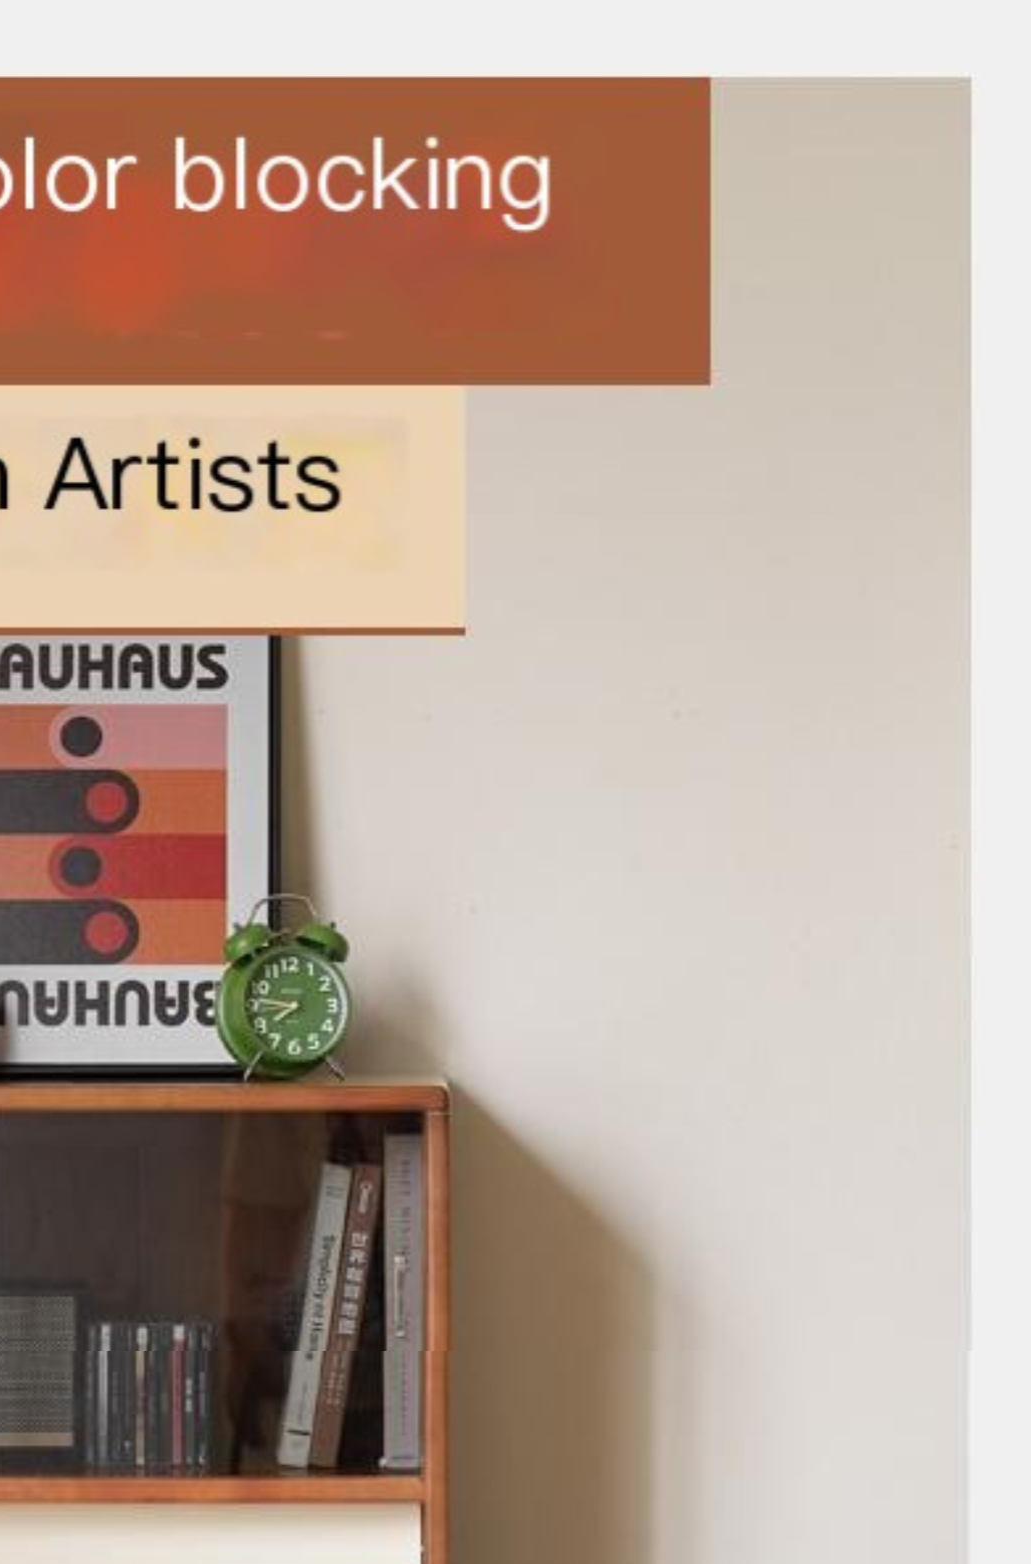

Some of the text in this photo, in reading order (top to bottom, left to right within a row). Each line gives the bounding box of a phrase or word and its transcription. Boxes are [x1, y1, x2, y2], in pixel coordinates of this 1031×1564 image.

[280, 956, 299, 973] 12
[306, 962, 315, 976] 1
[317, 975, 332, 992] 2
[326, 998, 338, 1014] 3
[320, 1018, 334, 1033] 4
[268, 1032, 282, 1050] 7
[287, 1037, 302, 1056] 6
[307, 1032, 320, 1050] 5
